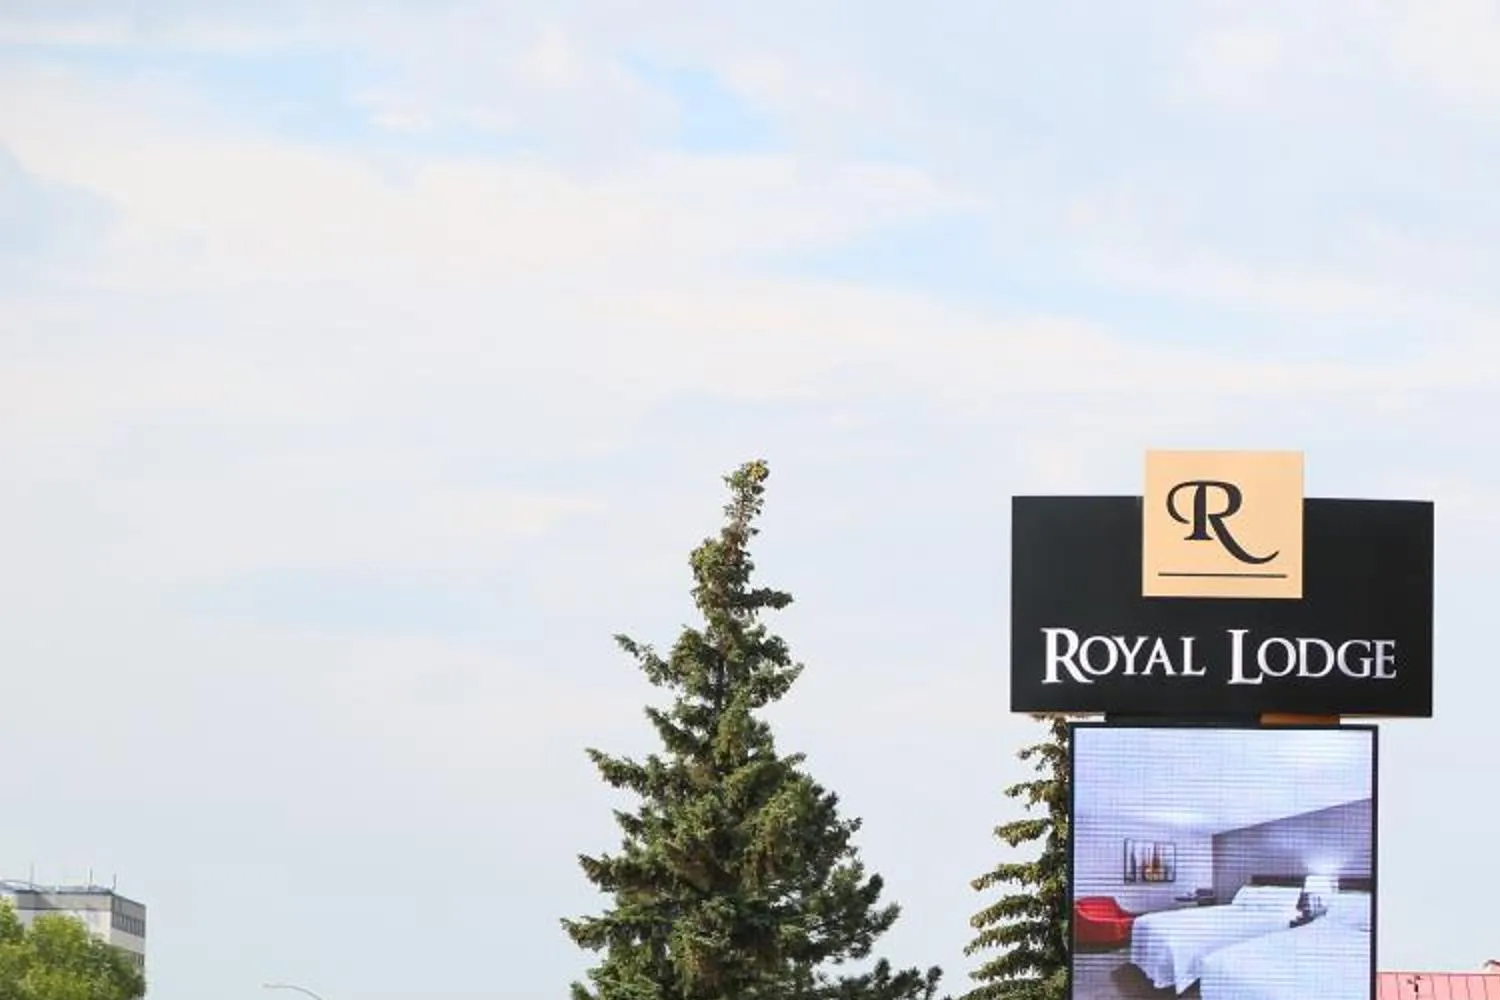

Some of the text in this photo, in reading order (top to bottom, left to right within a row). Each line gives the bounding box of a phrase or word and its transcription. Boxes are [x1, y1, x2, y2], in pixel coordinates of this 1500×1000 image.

[1166, 479, 1280, 565] R
[1040, 627, 1397, 686] ROYAL LODGE
